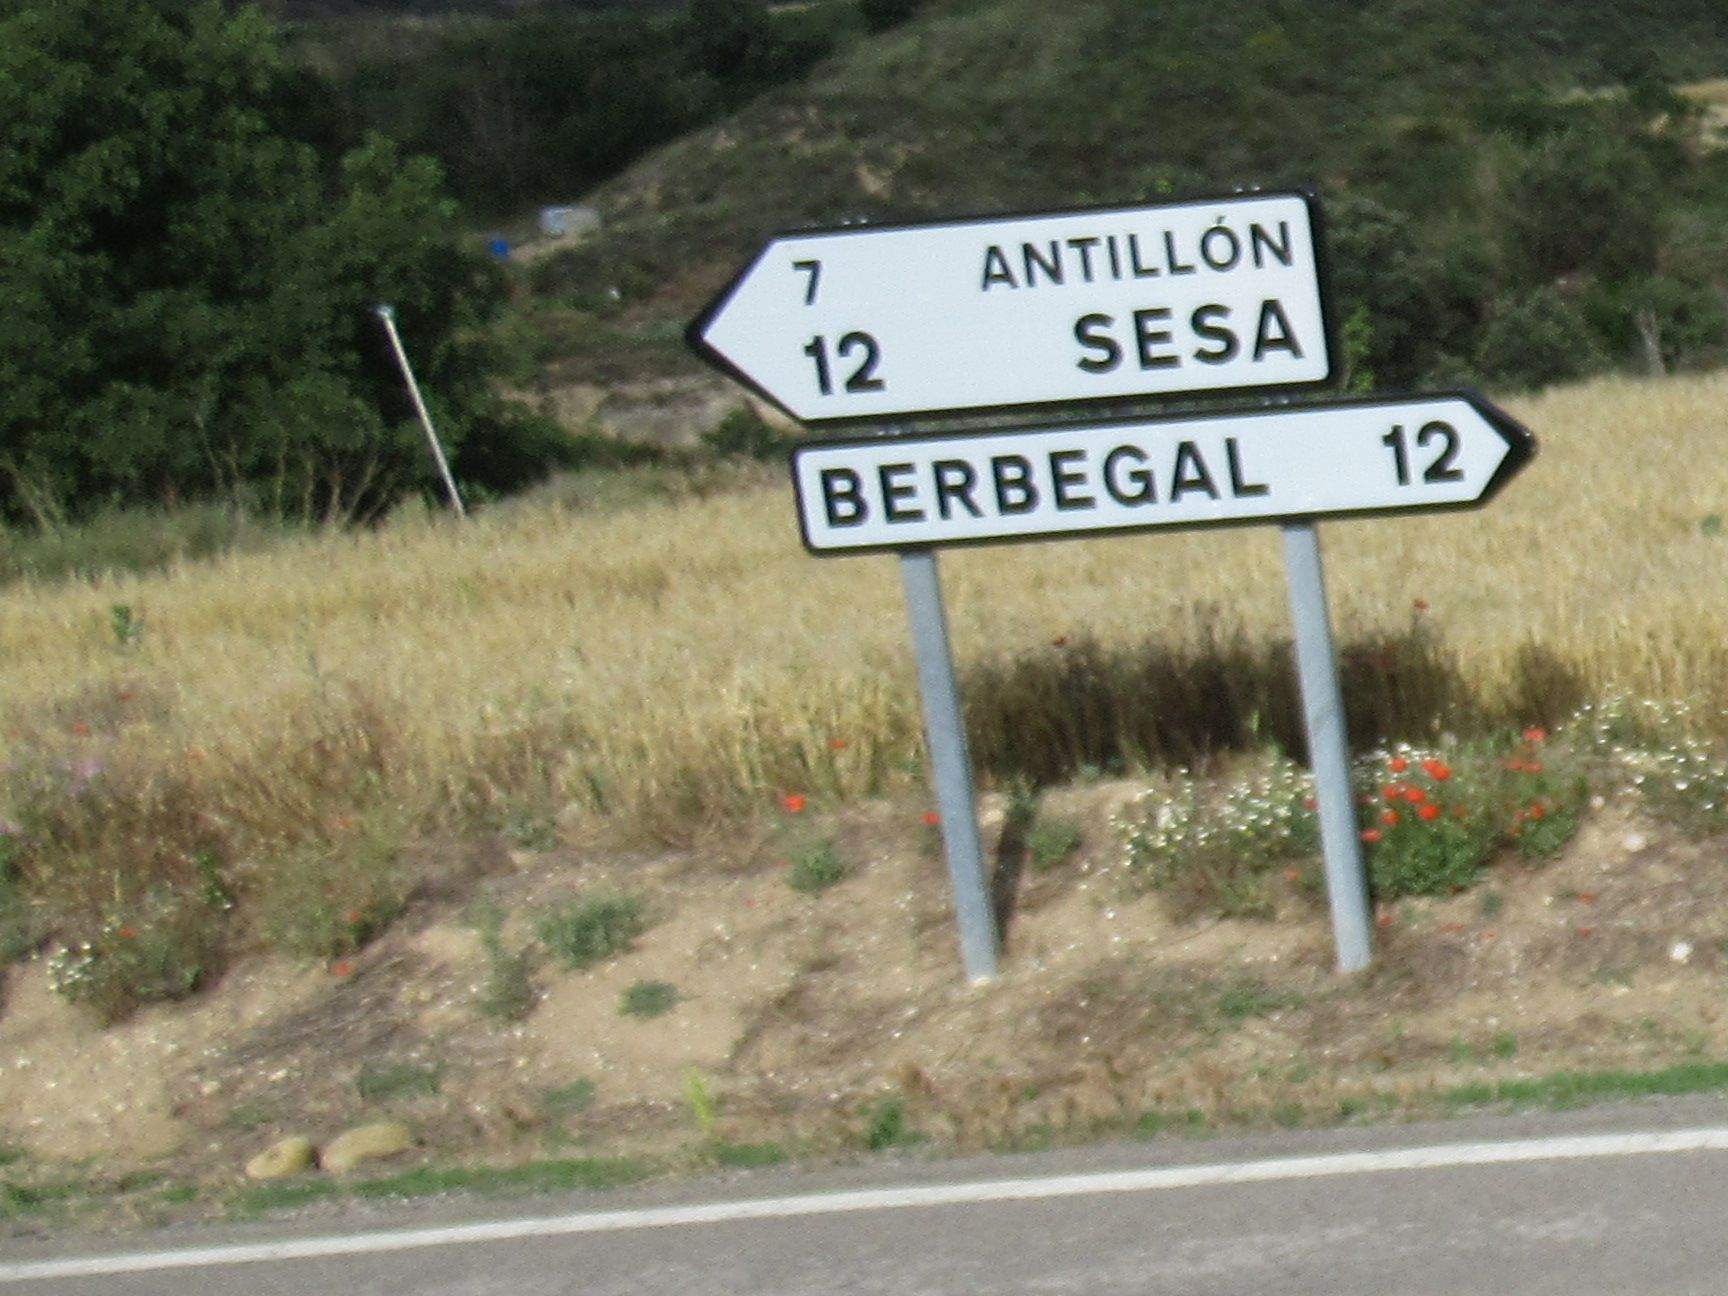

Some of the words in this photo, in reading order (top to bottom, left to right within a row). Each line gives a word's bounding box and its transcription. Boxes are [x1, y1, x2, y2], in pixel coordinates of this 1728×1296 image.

[791, 259, 822, 307] 7
[981, 215, 1293, 292] ANTILLÓN
[803, 330, 885, 397] 12
[1072, 298, 1303, 375] SESA
[819, 436, 1270, 529] BERBEGAL
[1381, 419, 1464, 487] 12
